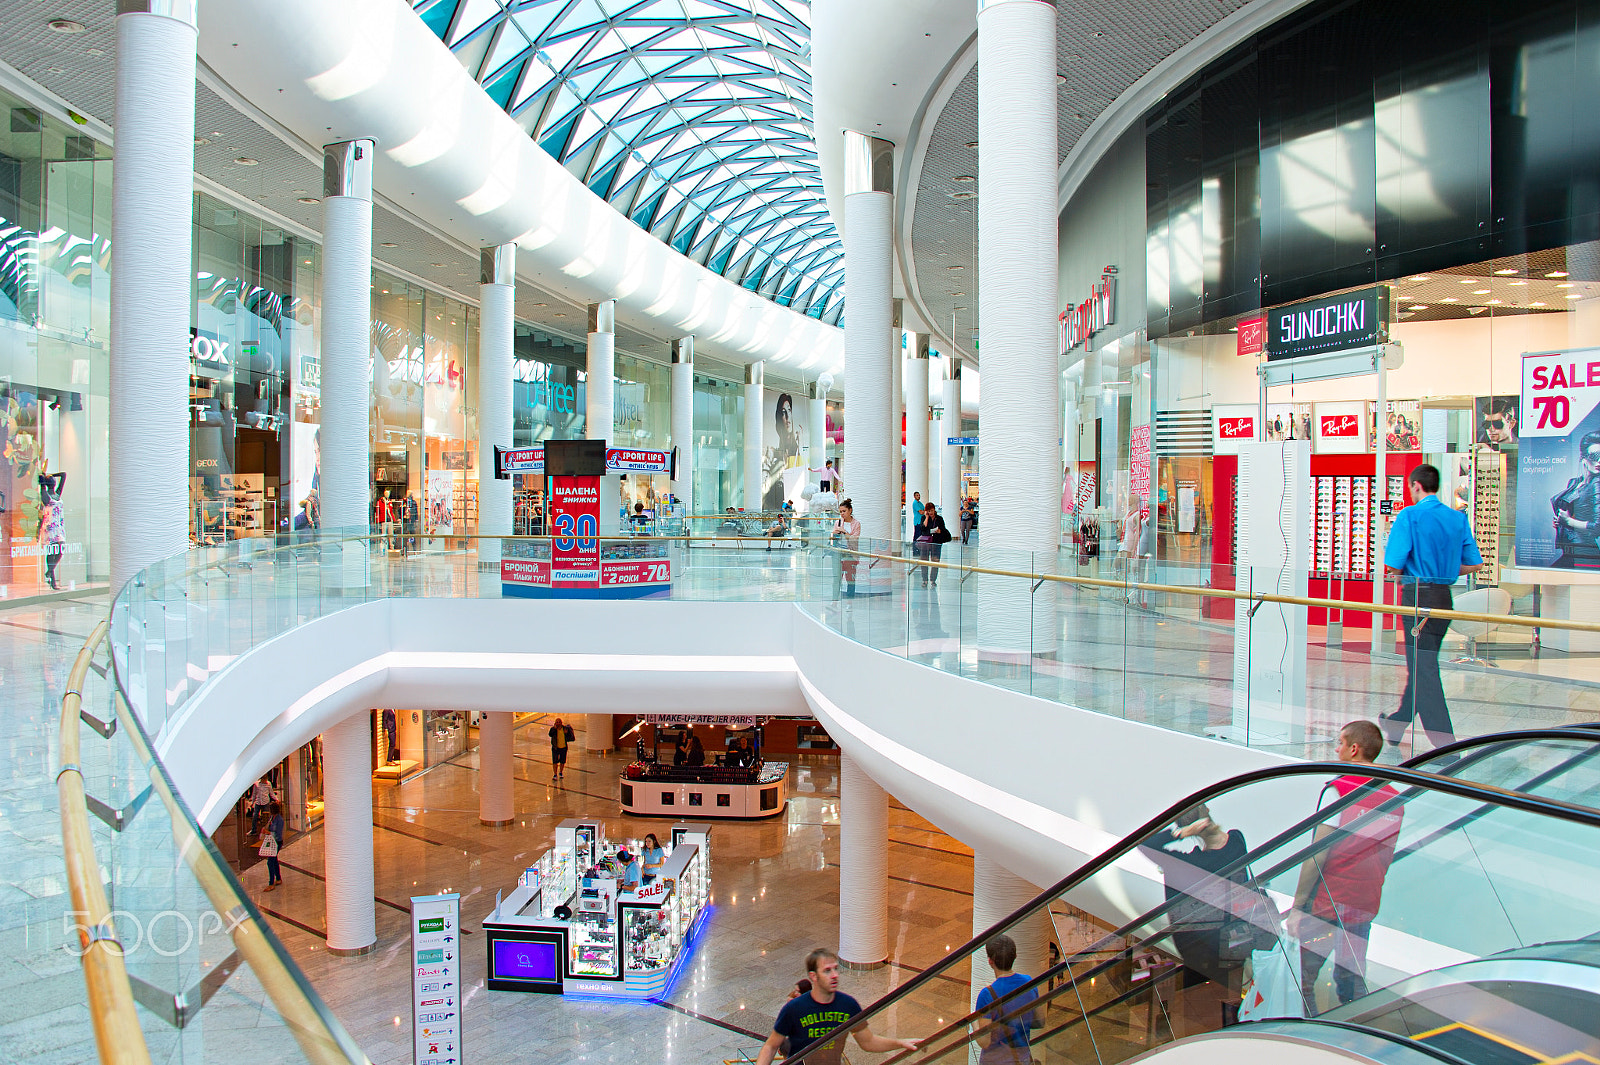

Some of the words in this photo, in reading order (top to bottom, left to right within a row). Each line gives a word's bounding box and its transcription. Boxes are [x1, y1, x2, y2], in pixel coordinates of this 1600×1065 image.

[1281, 300, 1365, 343] SUNOCHKI
[189, 335, 229, 364] OX
[1532, 361, 1600, 391] SALE
[1399, 401, 1419, 412] HIDE
[622, 452, 646, 461] SPORT
[196, 459, 218, 467] GEOX
[555, 487, 597, 495] ШАЛЕНА
[555, 513, 597, 552] 30
[504, 563, 539, 573] БРОНЮЙ
[642, 563, 670, 582] -70%
[555, 571, 597, 579] Поспішай!
[608, 573, 617, 583] 2
[729, 716, 752, 724] PARIS
[638, 883, 663, 899] SALE!
[799, 1011, 851, 1028] HOLLISTER
